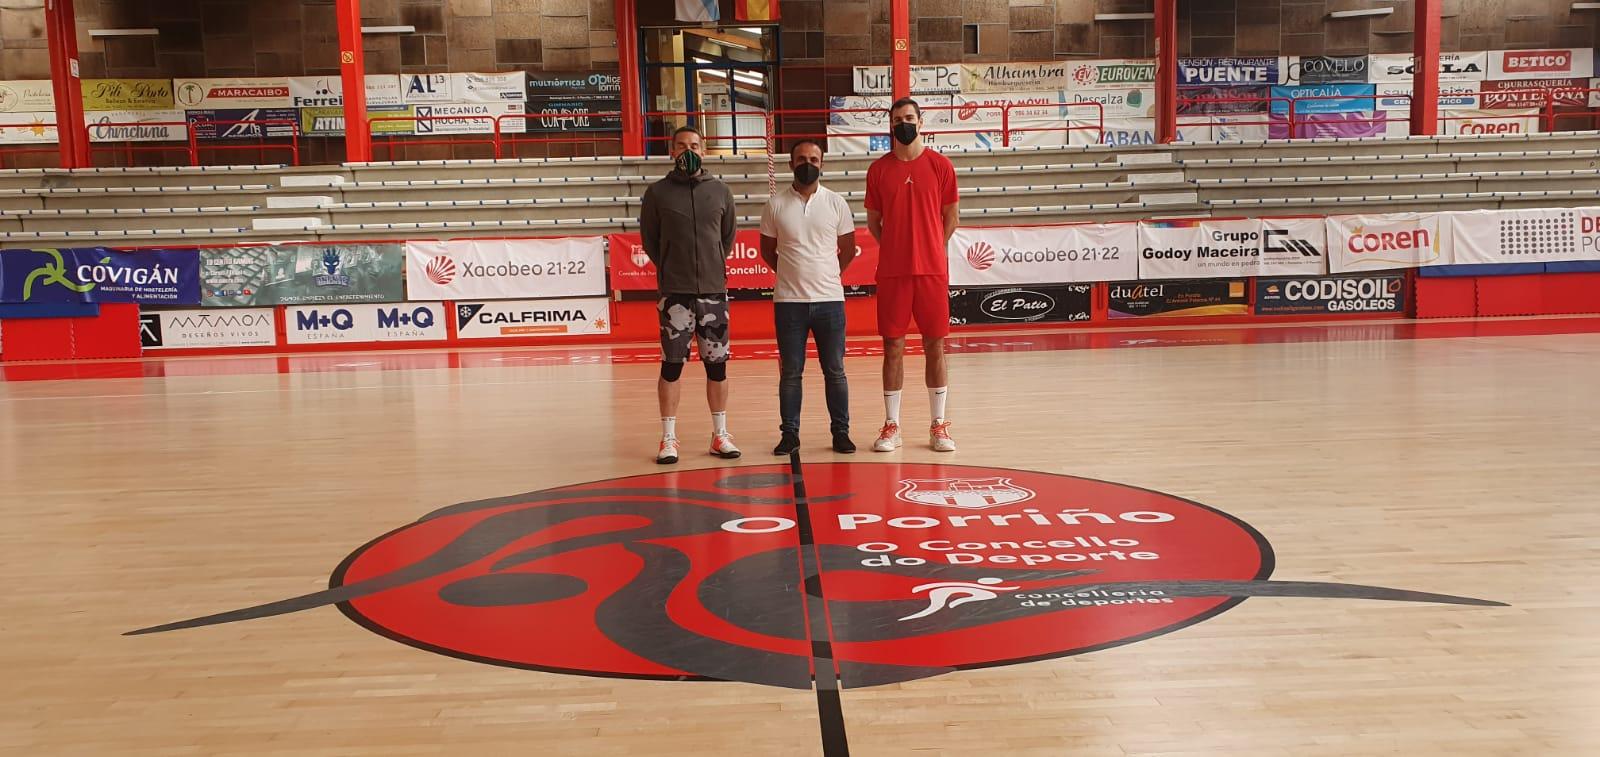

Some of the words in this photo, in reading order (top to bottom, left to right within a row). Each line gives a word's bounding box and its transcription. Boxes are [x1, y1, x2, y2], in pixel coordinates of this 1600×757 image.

[1218, 57, 1275, 66] RESTAURANTE
[1303, 58, 1365, 74] COVELO
[1506, 54, 1566, 68] BETICO
[983, 65, 1065, 81] Alhambra
[1099, 65, 1155, 82] EUROVEN
[1185, 66, 1268, 83] PUENTE
[91, 82, 122, 98] Pili
[1497, 79, 1573, 89] CHURRASQUERÍA
[217, 88, 283, 98] MARACAIBO
[1074, 93, 1123, 105] Descalza
[293, 96, 343, 107] Ferrei
[983, 99, 1014, 107] PIZZA
[434, 105, 489, 115] MECANICA
[1211, 229, 1259, 247] Grupo
[1001, 247, 1079, 264] Xacobeo
[1142, 247, 1192, 262] Godoy
[1197, 244, 1260, 259] Maceira
[462, 260, 543, 278] Xacobeo
[1110, 284, 1165, 300] duatel
[1284, 278, 1396, 301] CODISOIL
[990, 298, 1008, 312] El
[1012, 297, 1048, 310] Patio
[1327, 298, 1396, 311] GASÓLEOS
[296, 308, 354, 331] M+Q
[377, 306, 434, 329] M+Q
[478, 309, 587, 325] CALFRIMA
[720, 515, 797, 535] O
[836, 507, 1177, 531] Porriño
[856, 542, 899, 553] O
[918, 535, 1142, 551] Concello
[860, 553, 927, 568] do
[945, 549, 1161, 566] Deporte
[1019, 598, 1052, 608] de
[1060, 596, 1175, 608] deportes
